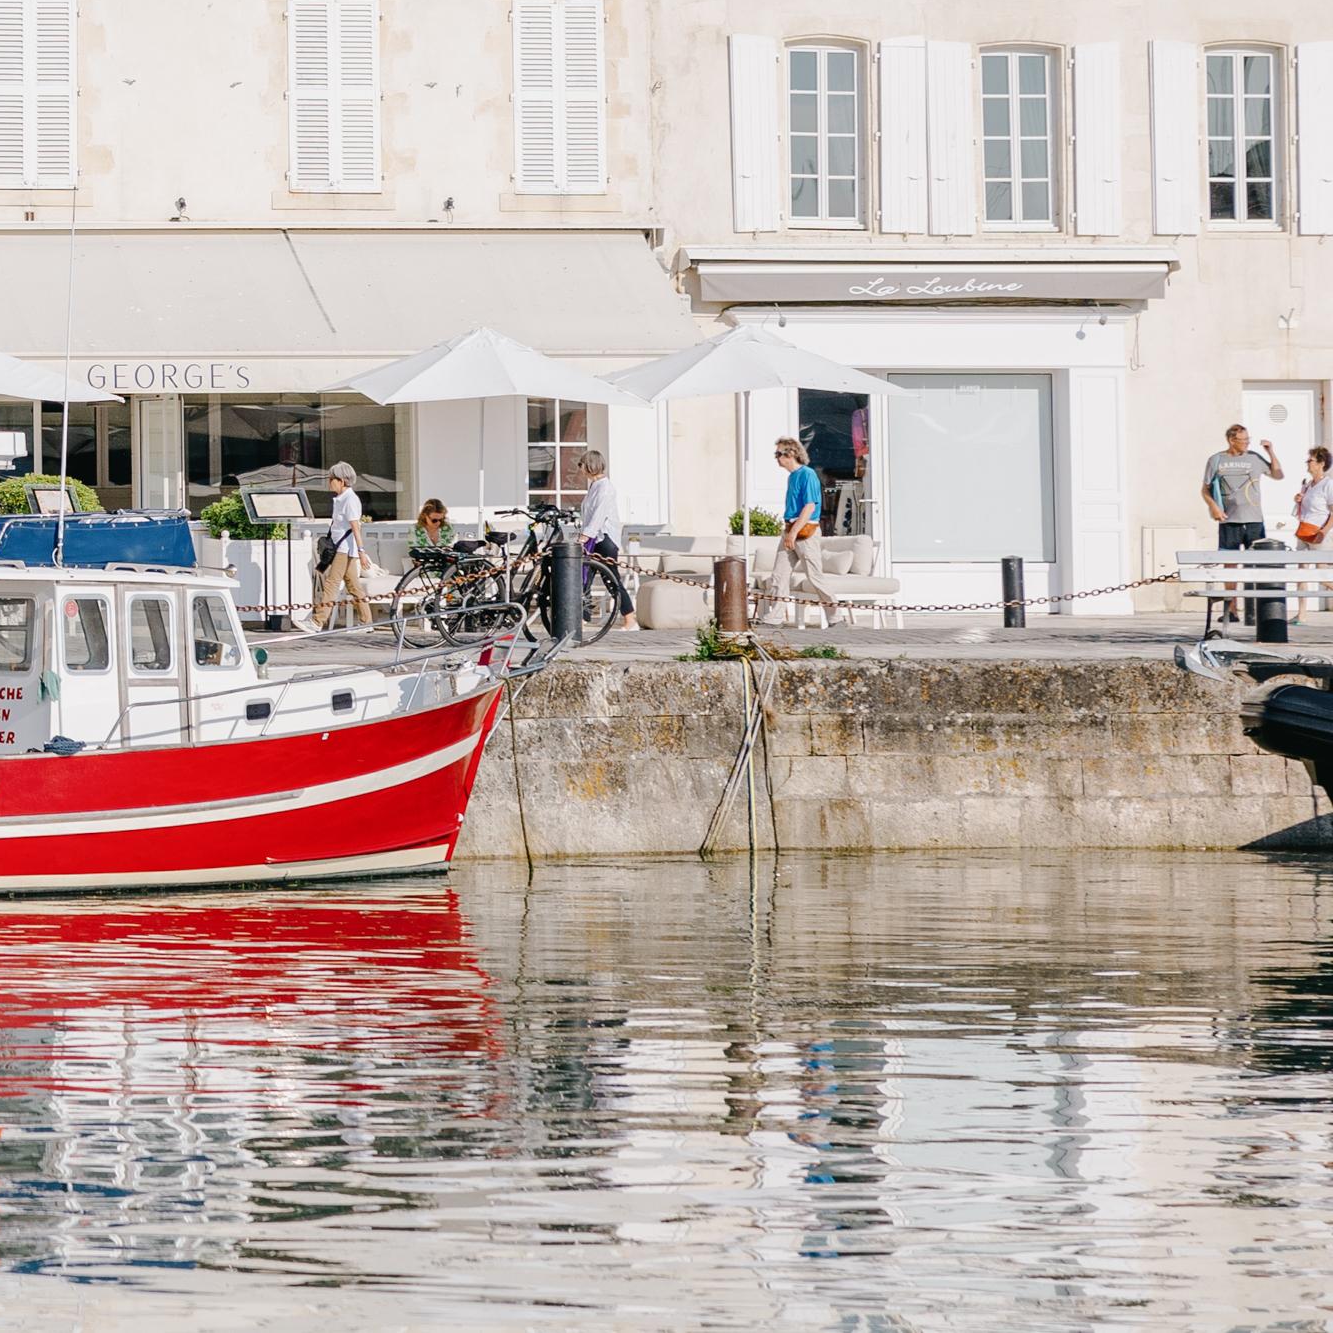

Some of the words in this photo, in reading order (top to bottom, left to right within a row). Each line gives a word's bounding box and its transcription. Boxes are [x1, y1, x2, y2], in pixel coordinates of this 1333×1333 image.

[849, 277, 899, 297] La
[906, 276, 1023, 295] Loubine
[87, 363, 250, 389] GEORGE'S
